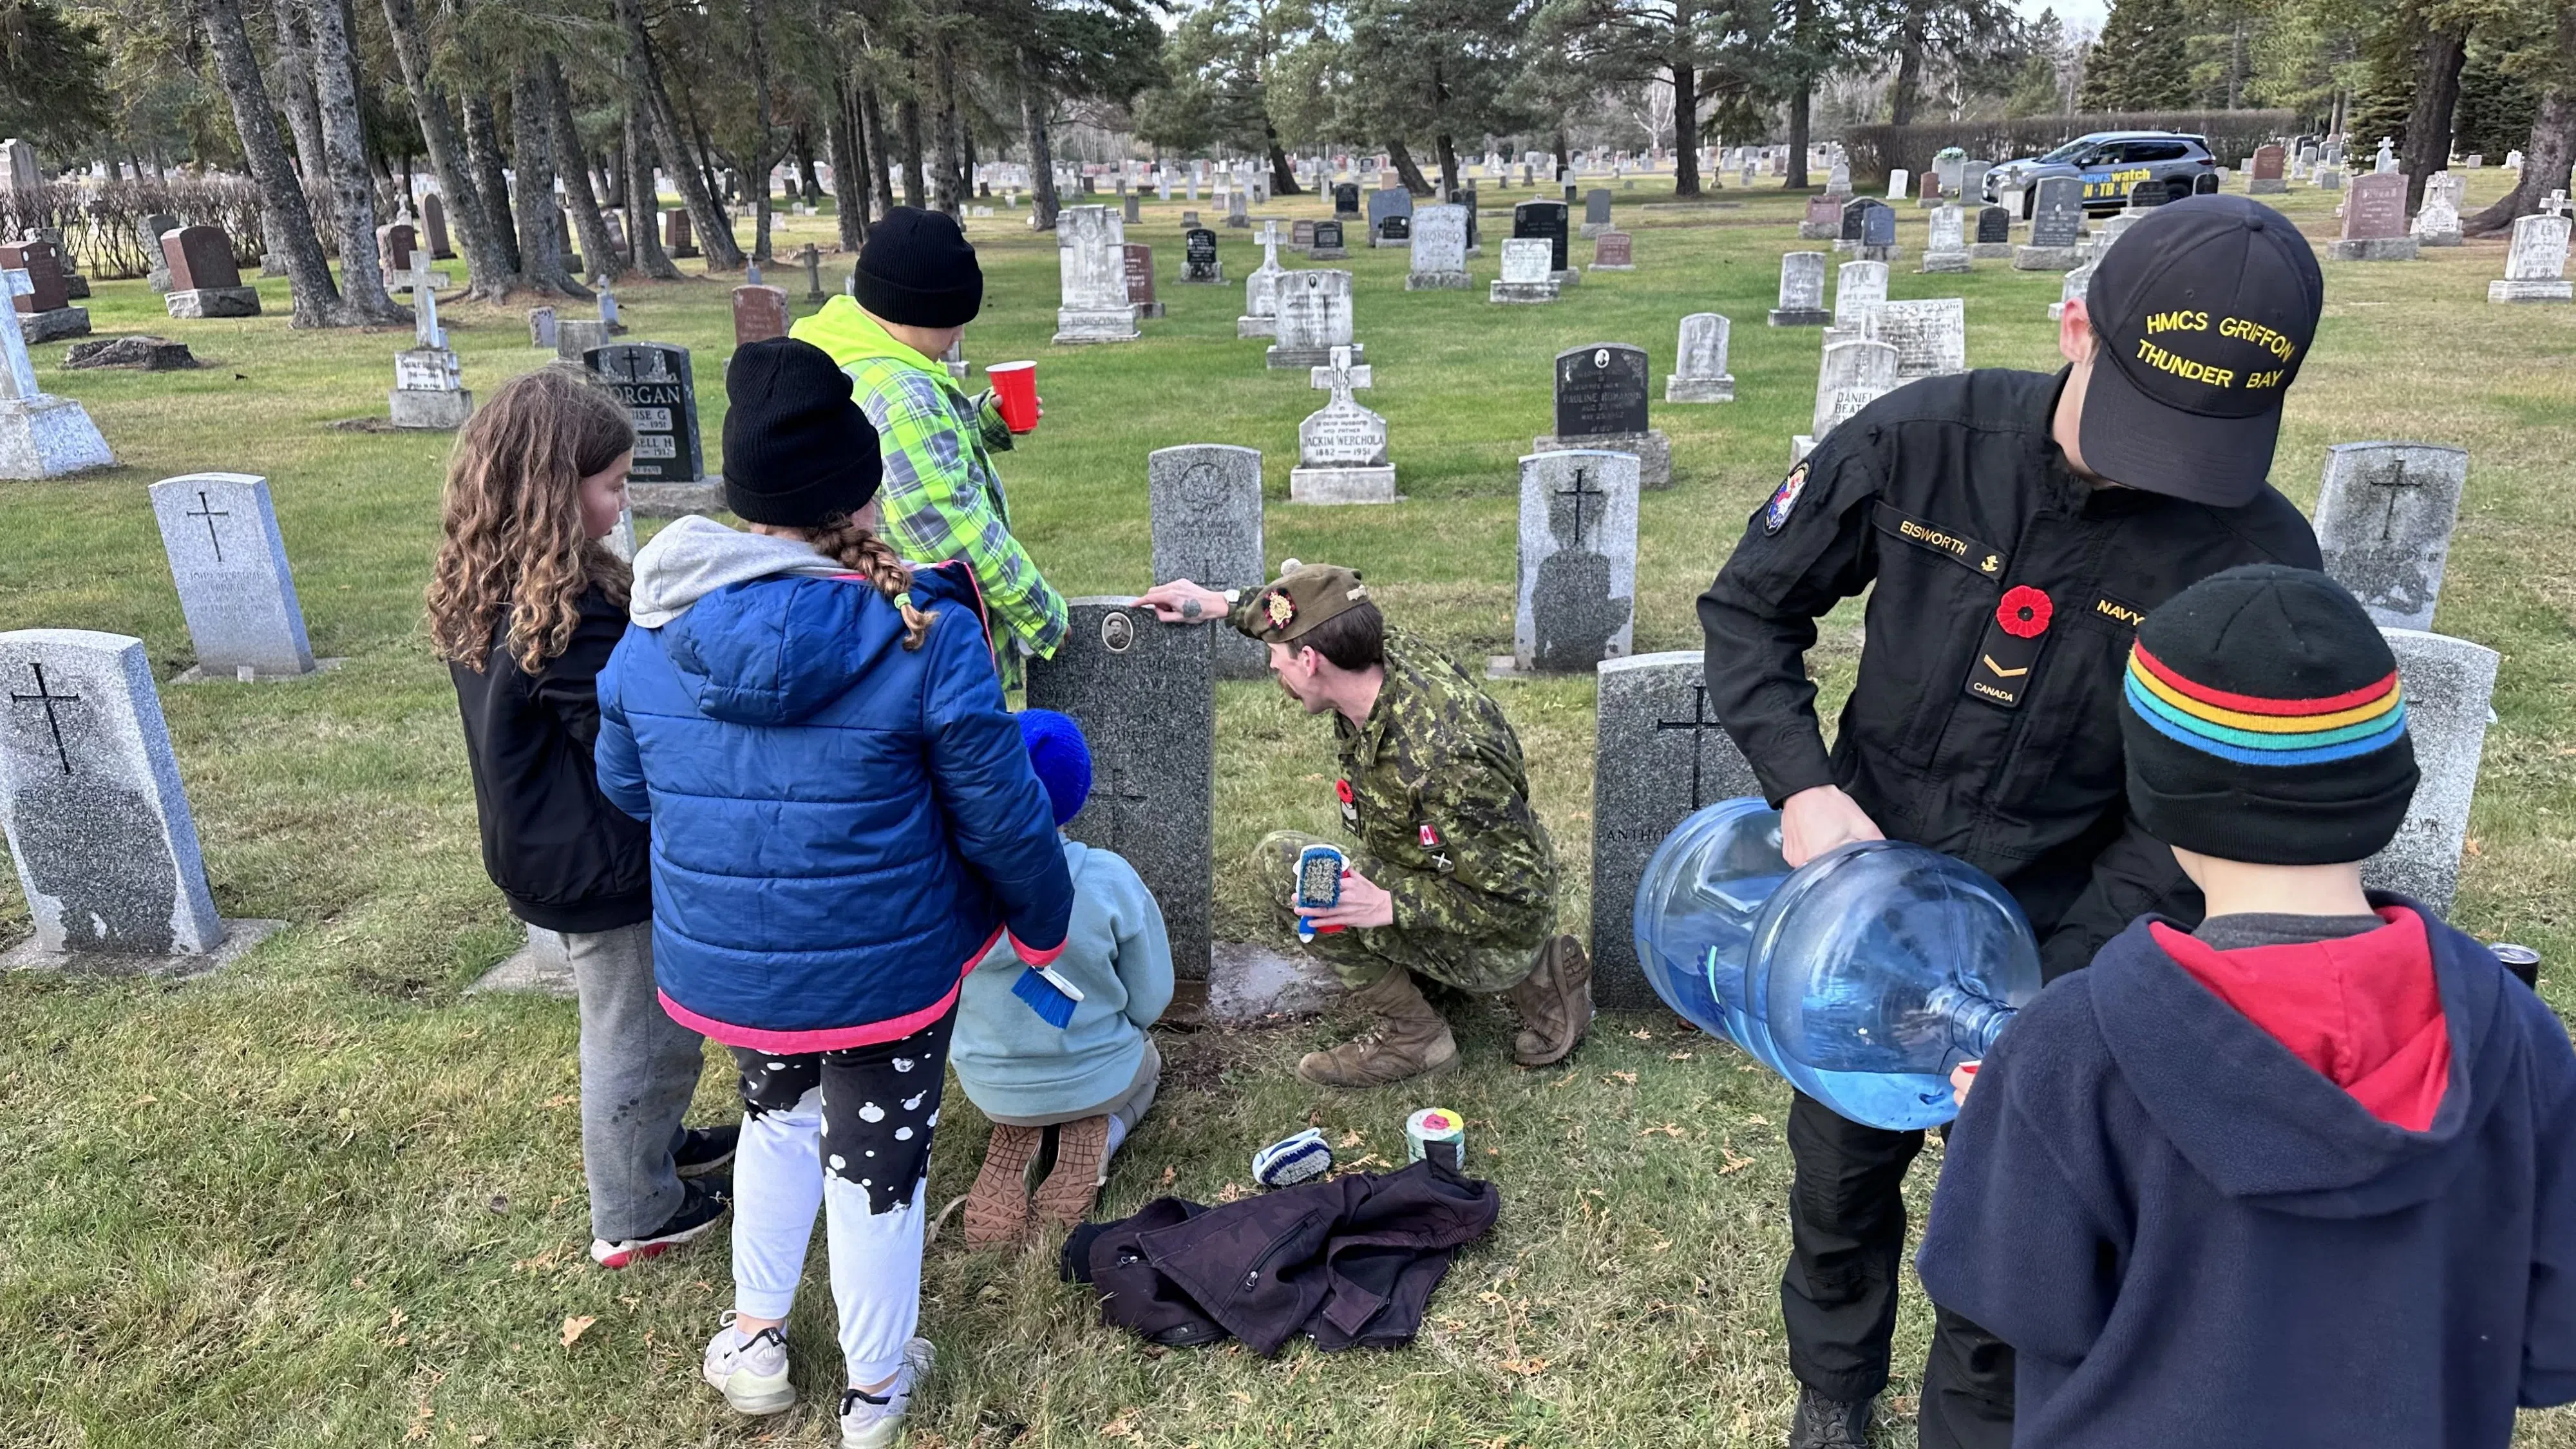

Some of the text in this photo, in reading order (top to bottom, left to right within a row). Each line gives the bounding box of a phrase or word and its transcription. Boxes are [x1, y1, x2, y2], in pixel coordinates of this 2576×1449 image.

[2146, 310, 2295, 363] HMCS GRIFFON
[2136, 338, 2285, 388] THUNDER BAY
[611, 385, 680, 404] ORGAN
[658, 410, 667, 420] G
[1835, 403, 1866, 414] BEAT
[634, 438, 659, 448] SELL
[1336, 435, 1384, 446] WERCHOLA
[1900, 520, 1967, 556] EISWORTH
[2097, 599, 2145, 627] NAVY
[1973, 681, 2014, 703] CANADA
[1606, 828, 1672, 842] ANTHO
